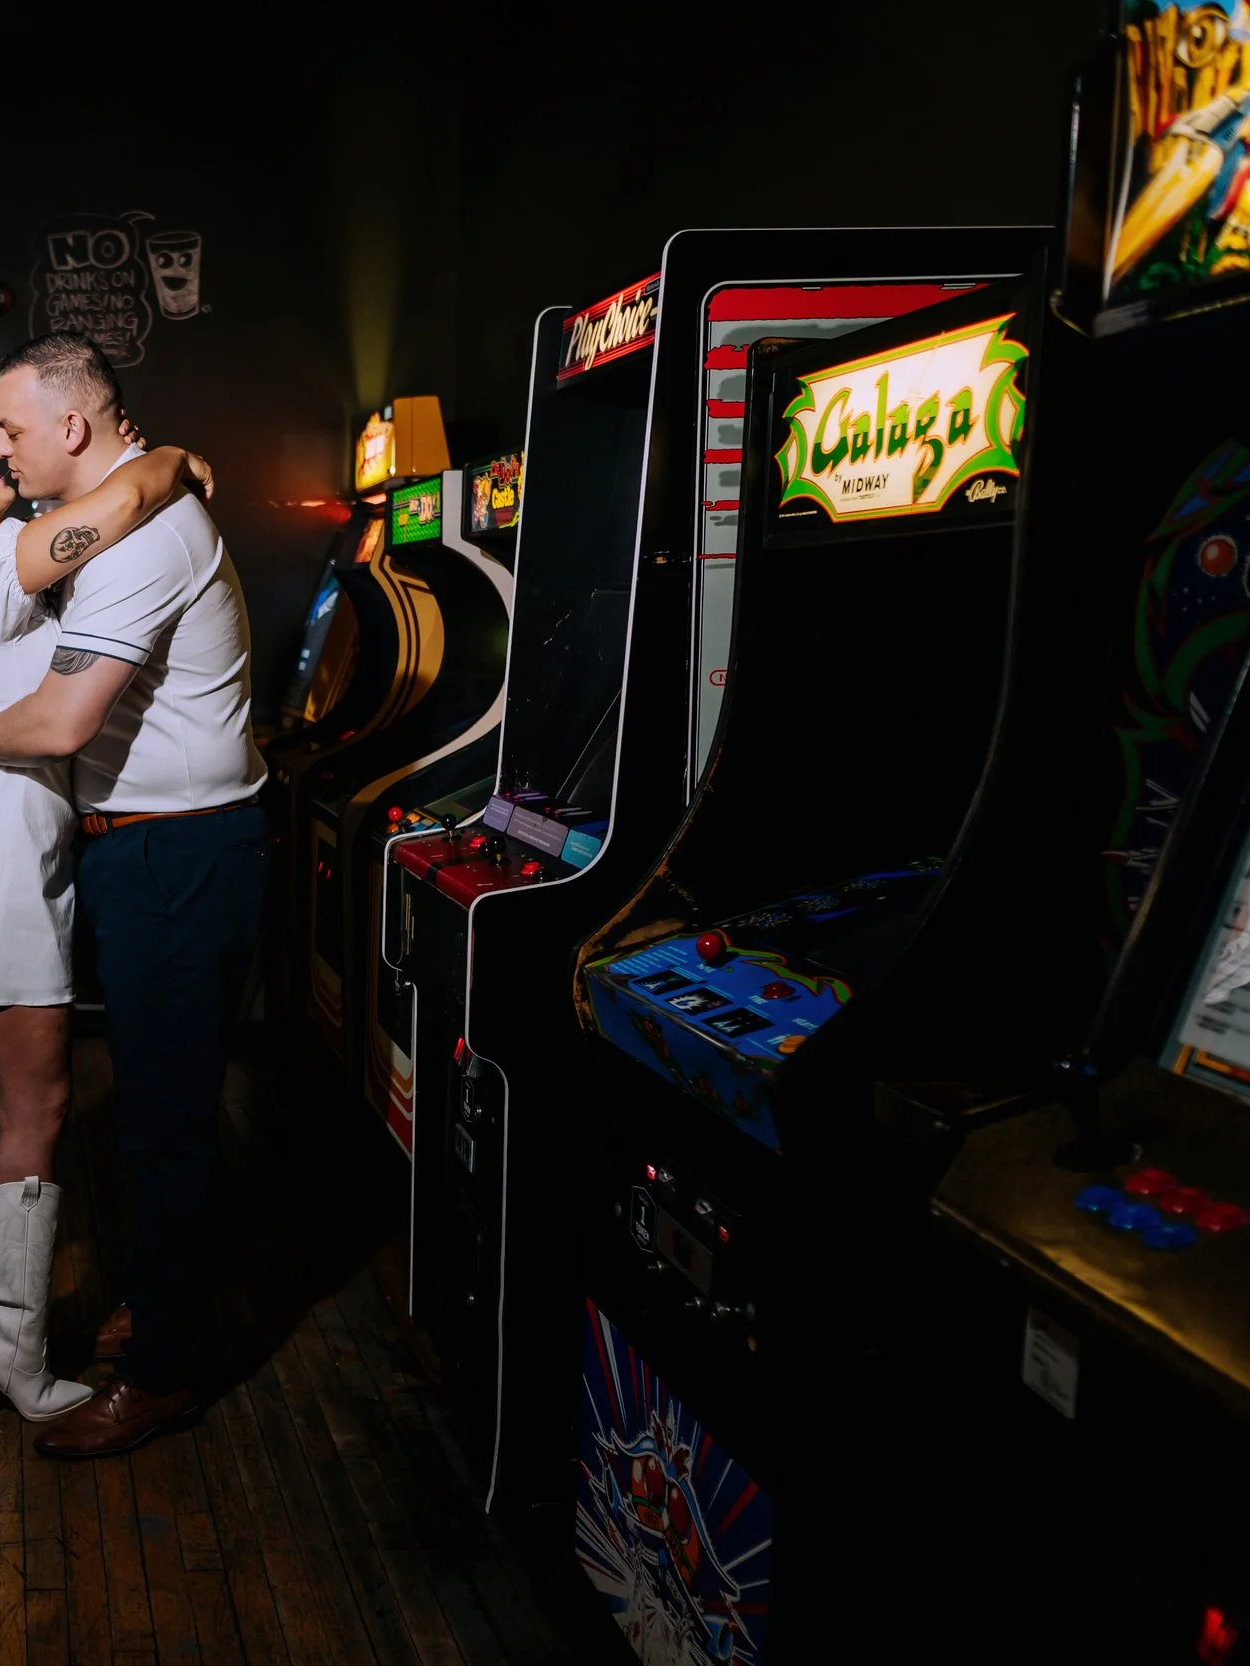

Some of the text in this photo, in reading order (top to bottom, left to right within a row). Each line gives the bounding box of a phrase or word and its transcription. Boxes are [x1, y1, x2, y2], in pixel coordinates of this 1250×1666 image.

[47, 229, 130, 270] NO
[46, 269, 135, 293] DRINKS ON
[811, 370, 980, 504] Galaga
[842, 474, 890, 495] MIDWAY
